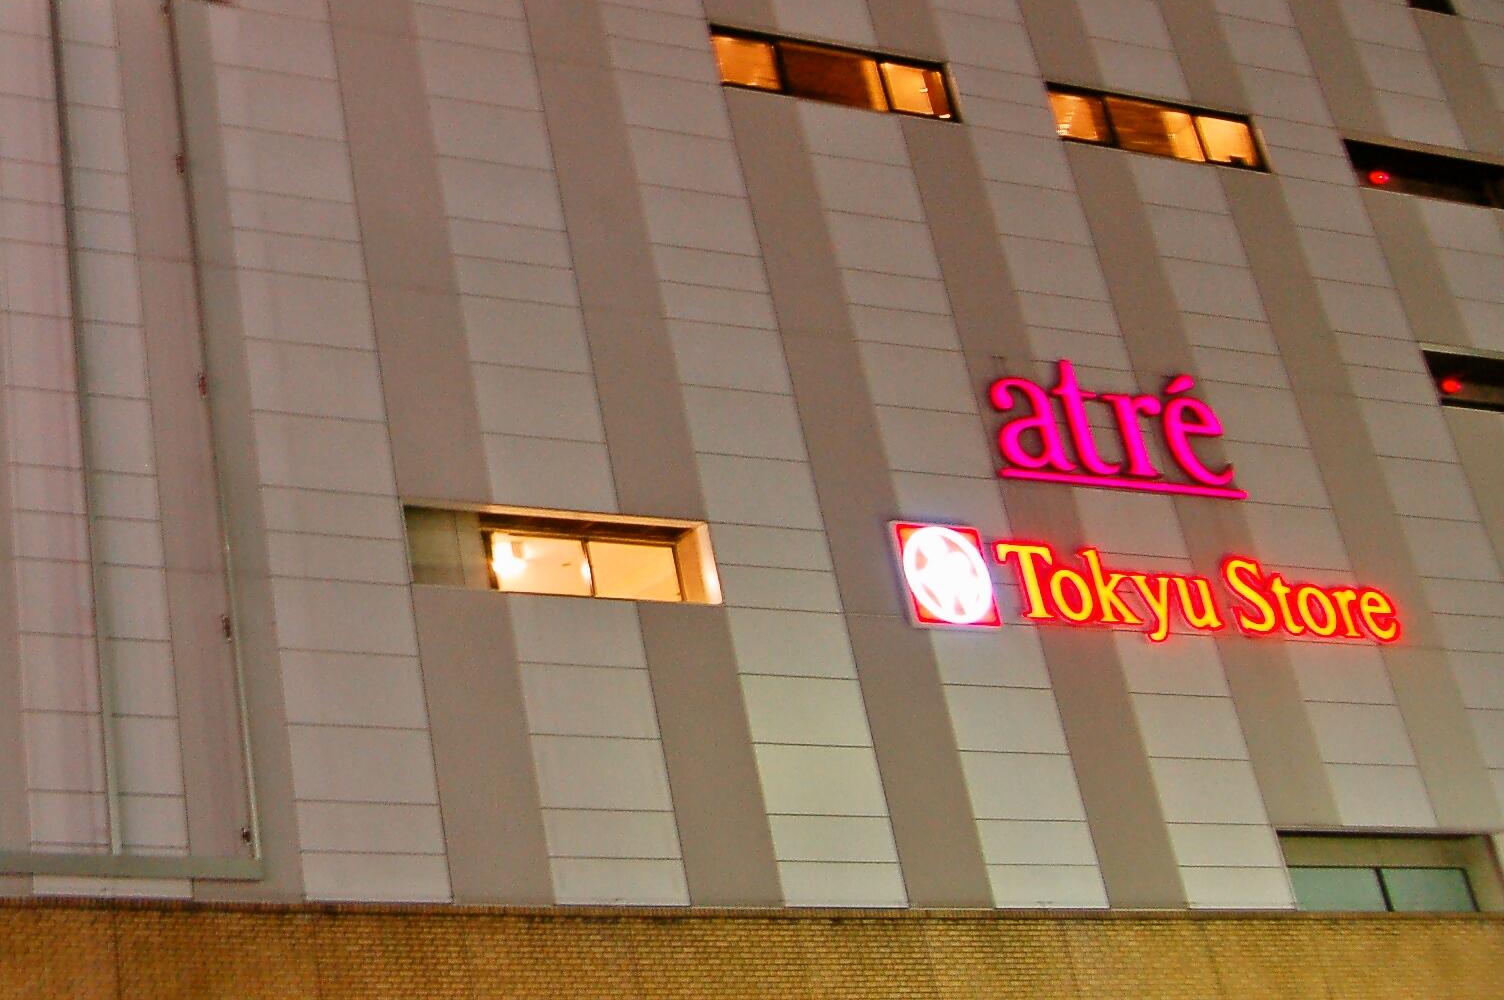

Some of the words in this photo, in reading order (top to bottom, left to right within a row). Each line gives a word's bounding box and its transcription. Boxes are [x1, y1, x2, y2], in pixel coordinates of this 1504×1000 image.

[990, 359, 1234, 486] atré
[995, 540, 1226, 643] Tokyu
[1221, 554, 1402, 643] Store
